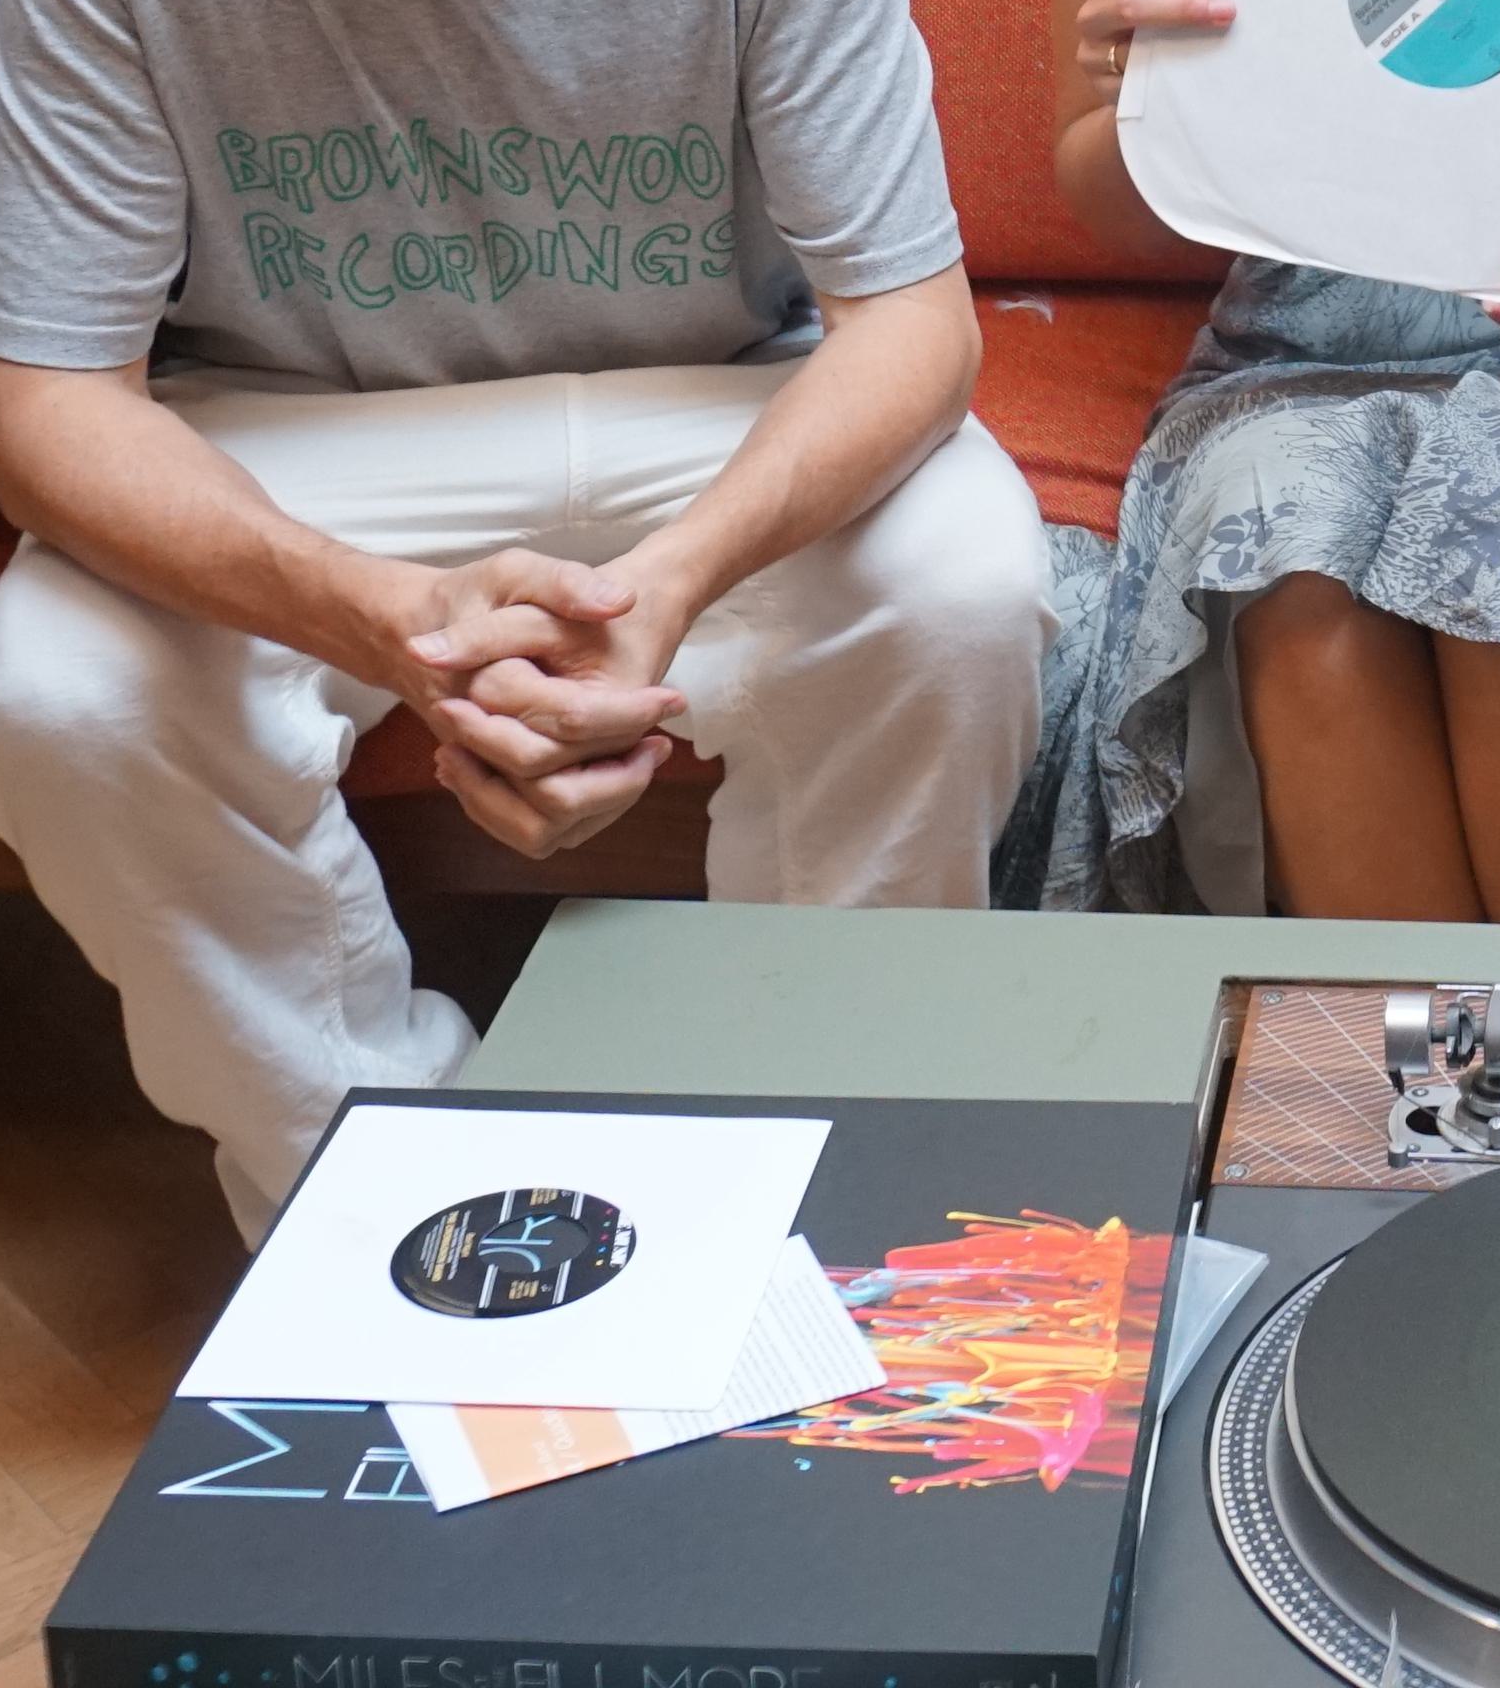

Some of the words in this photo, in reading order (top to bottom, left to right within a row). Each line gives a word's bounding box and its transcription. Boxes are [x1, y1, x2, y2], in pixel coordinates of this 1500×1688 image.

[1380, 23, 1409, 48] SIDE
[1411, 11, 1421, 22] A
[216, 118, 726, 212] BROWNSWOO
[244, 211, 737, 309] RECORDINGS
